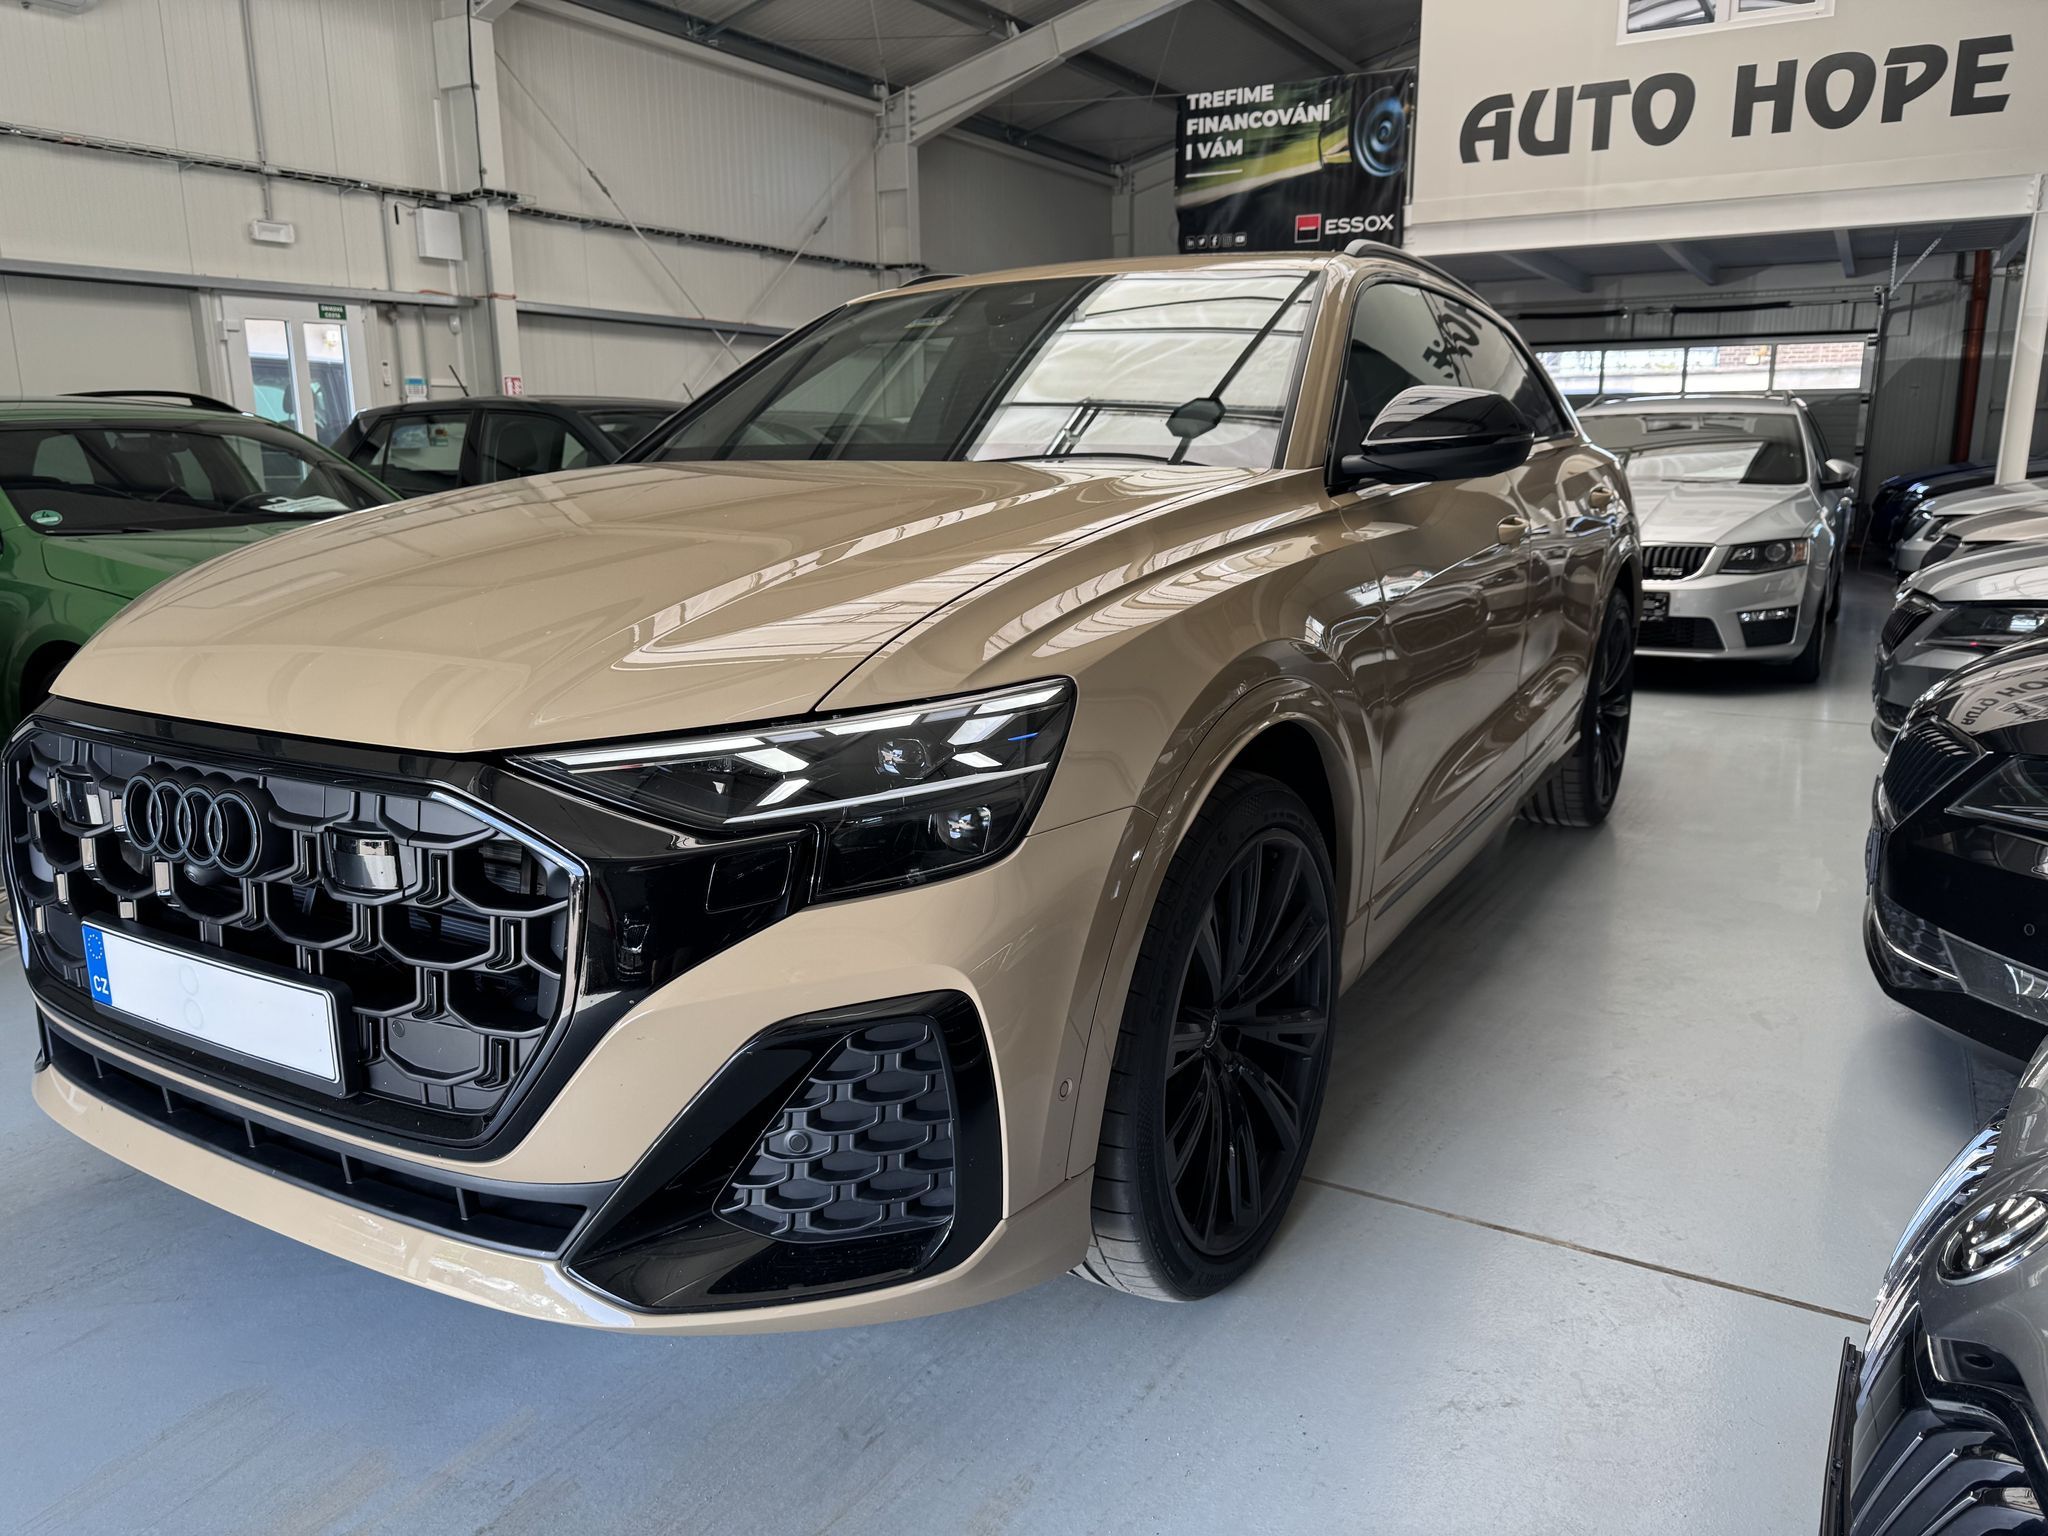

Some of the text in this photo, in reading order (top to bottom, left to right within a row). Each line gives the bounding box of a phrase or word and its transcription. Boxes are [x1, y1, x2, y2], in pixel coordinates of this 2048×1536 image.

[1186, 84, 1274, 110] TREFIME
[1459, 34, 2014, 164] AUTO HOPE
[1186, 98, 1332, 136] FINANCOVÁNÍ
[1185, 139, 1244, 161] I VÁM
[1325, 214, 1394, 235] ESSOX
[93, 975, 109, 995] CZ
